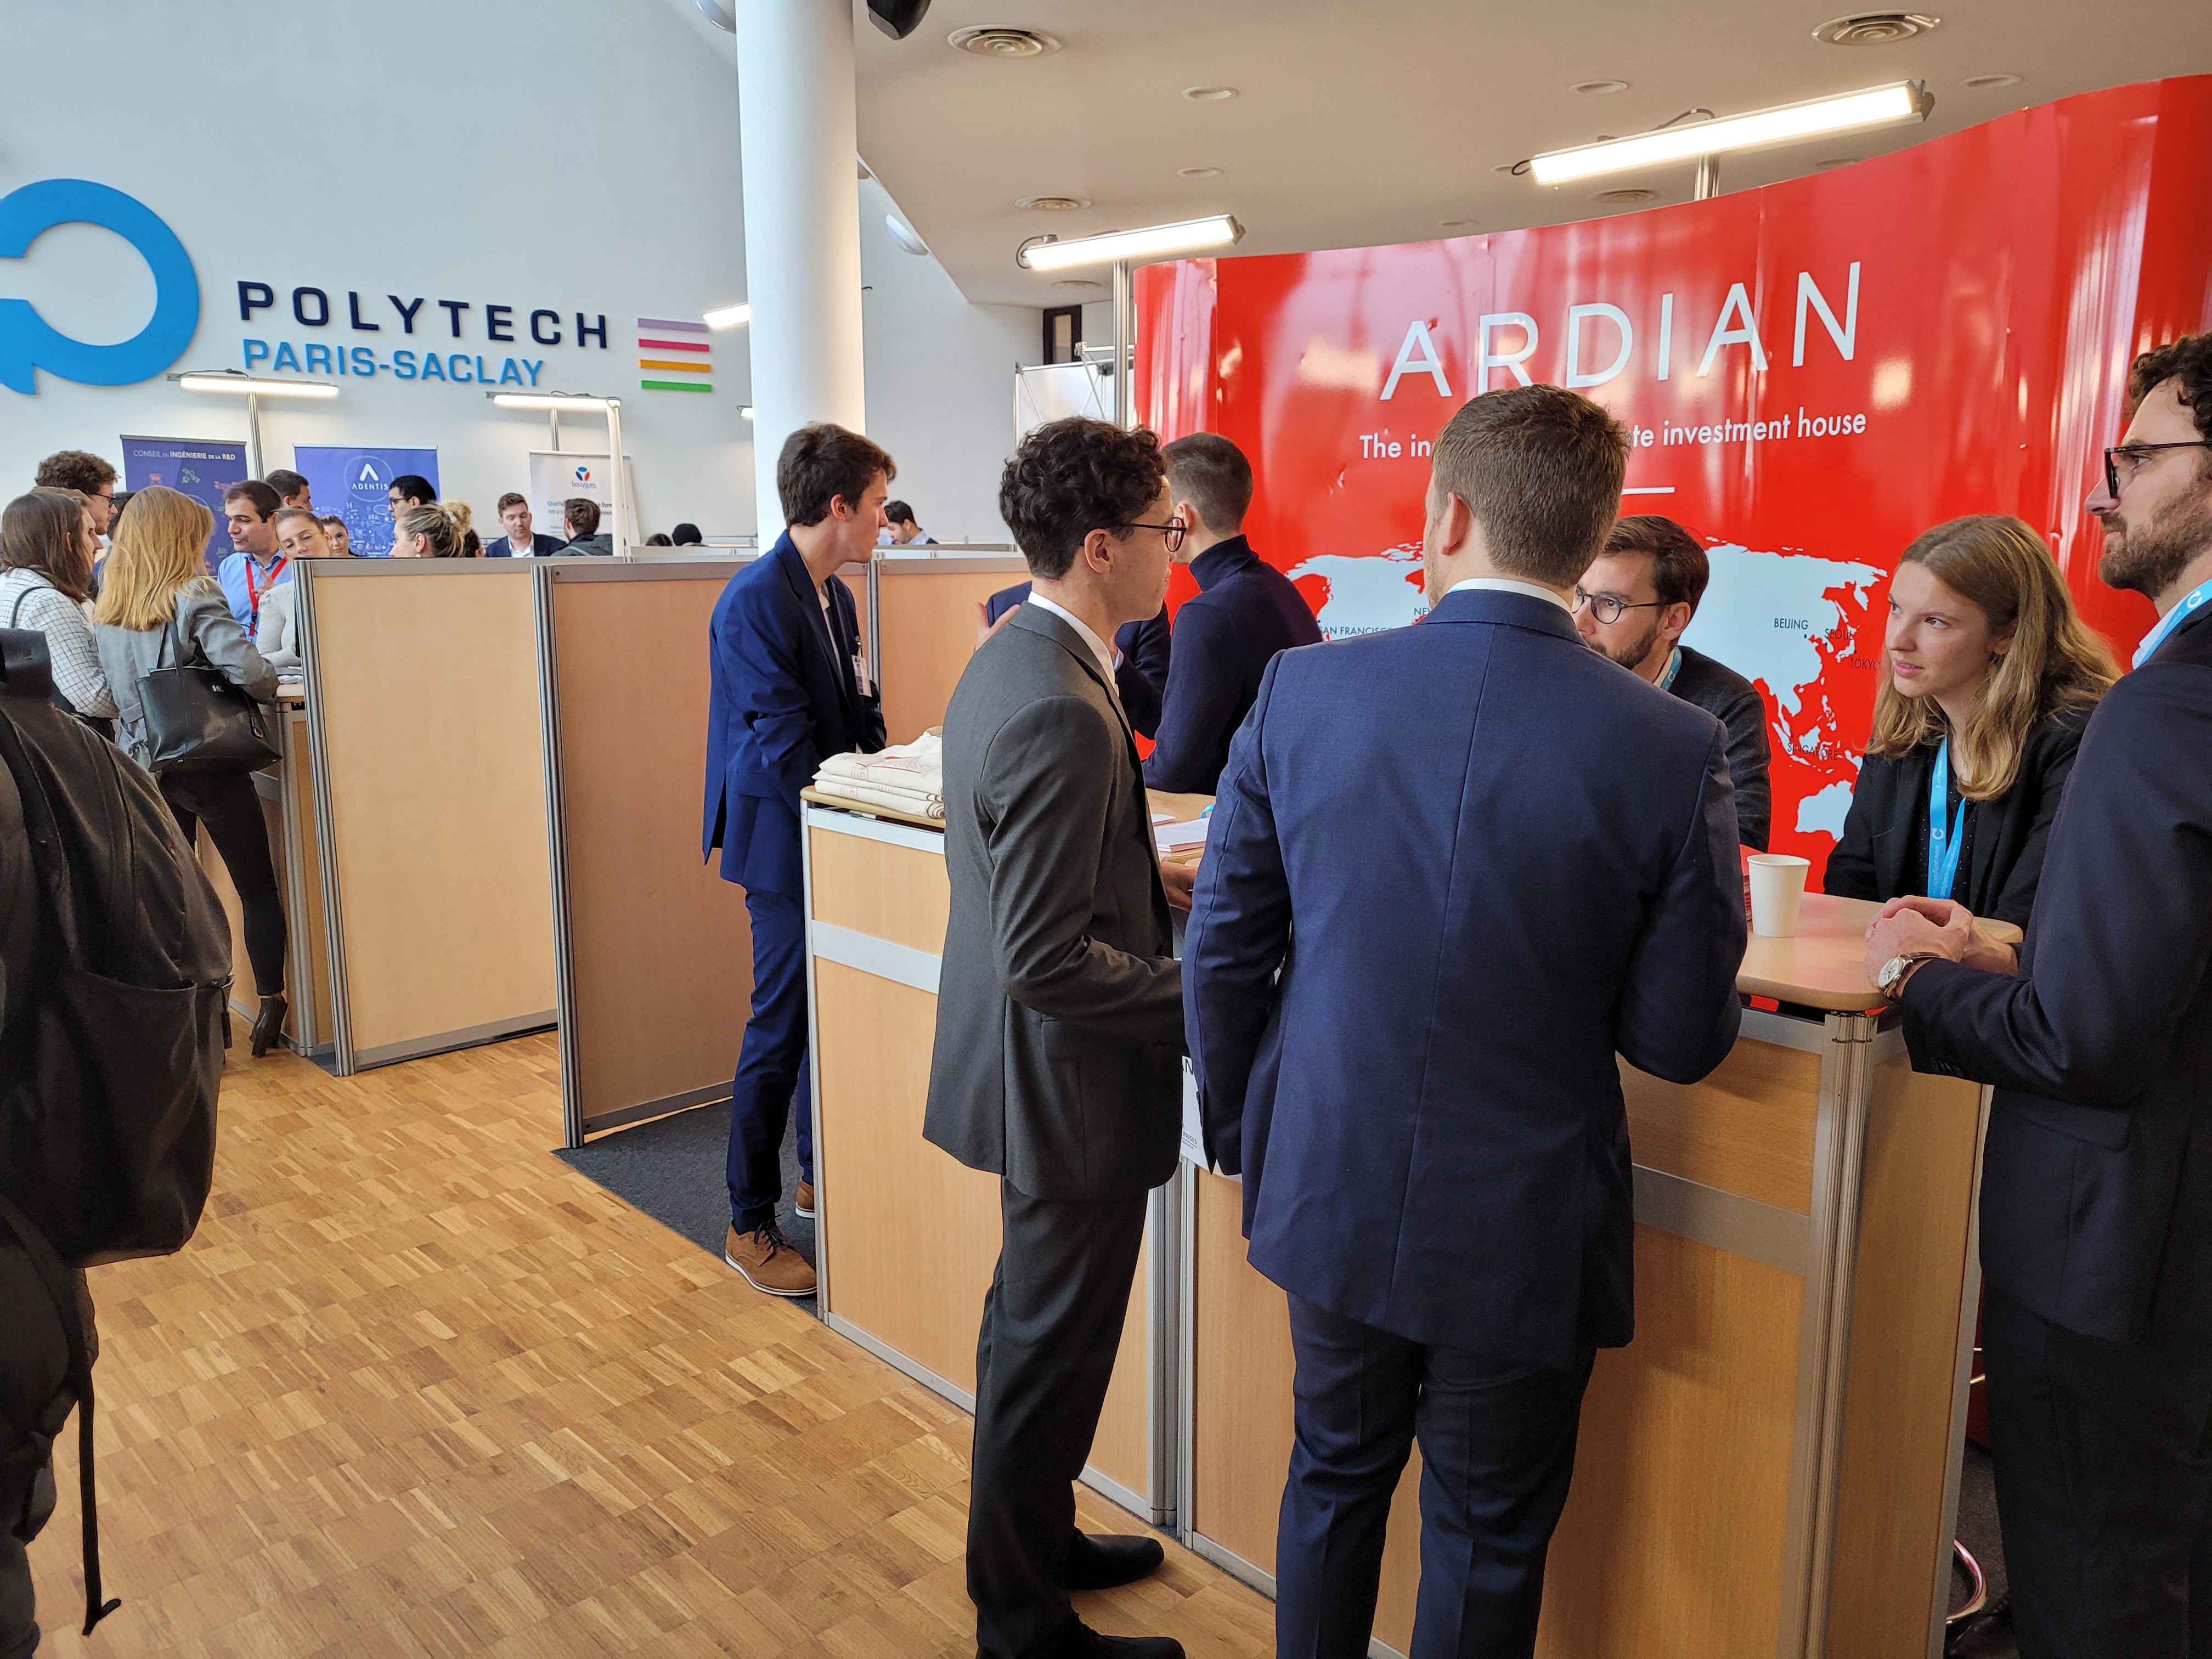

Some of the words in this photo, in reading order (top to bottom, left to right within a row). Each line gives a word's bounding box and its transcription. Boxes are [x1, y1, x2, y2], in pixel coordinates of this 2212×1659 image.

[237, 281, 607, 348] POLYTECH
[1380, 261, 1860, 400] ARDIAN
[242, 339, 543, 386] PARIS-SACLAY
[1359, 432, 1402, 459] The
[1662, 414, 1791, 445] investment
[1797, 407, 1866, 437] house
[572, 481, 596, 489] bouygues
[1340, 627, 1393, 635] FRANCIS
[1774, 618, 1808, 630] BEIJING
[1824, 628, 1853, 641] SEOUL
[1850, 658, 1880, 671] TOKYO
[1787, 742, 1838, 760] SINGAPORE
